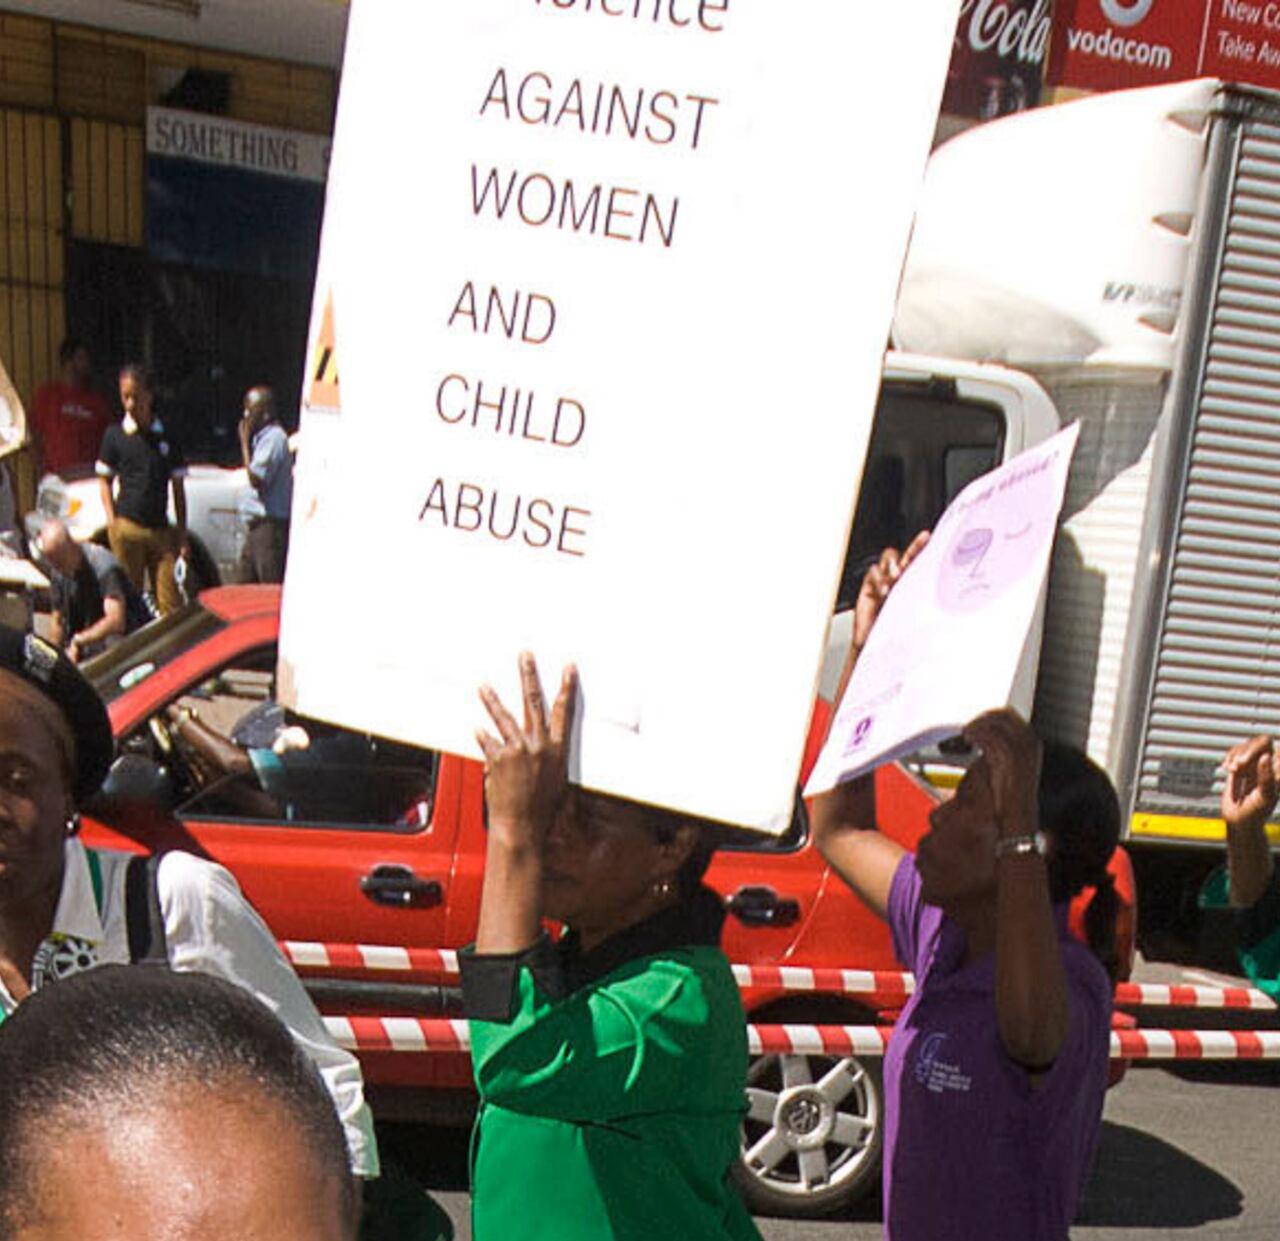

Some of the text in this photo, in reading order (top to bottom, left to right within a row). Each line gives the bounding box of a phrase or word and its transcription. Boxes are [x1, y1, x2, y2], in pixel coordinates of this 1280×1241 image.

[1222, 0, 1261, 24] New
[1067, 27, 1172, 70] vodacom
[1218, 30, 1255, 62] Take
[478, 66, 720, 151] AGAINST
[155, 115, 299, 172] SOMETHING
[469, 163, 680, 249] WOMEN
[446, 279, 558, 346] AND
[434, 372, 587, 449] CHILD
[417, 476, 592, 558] ABUSE
